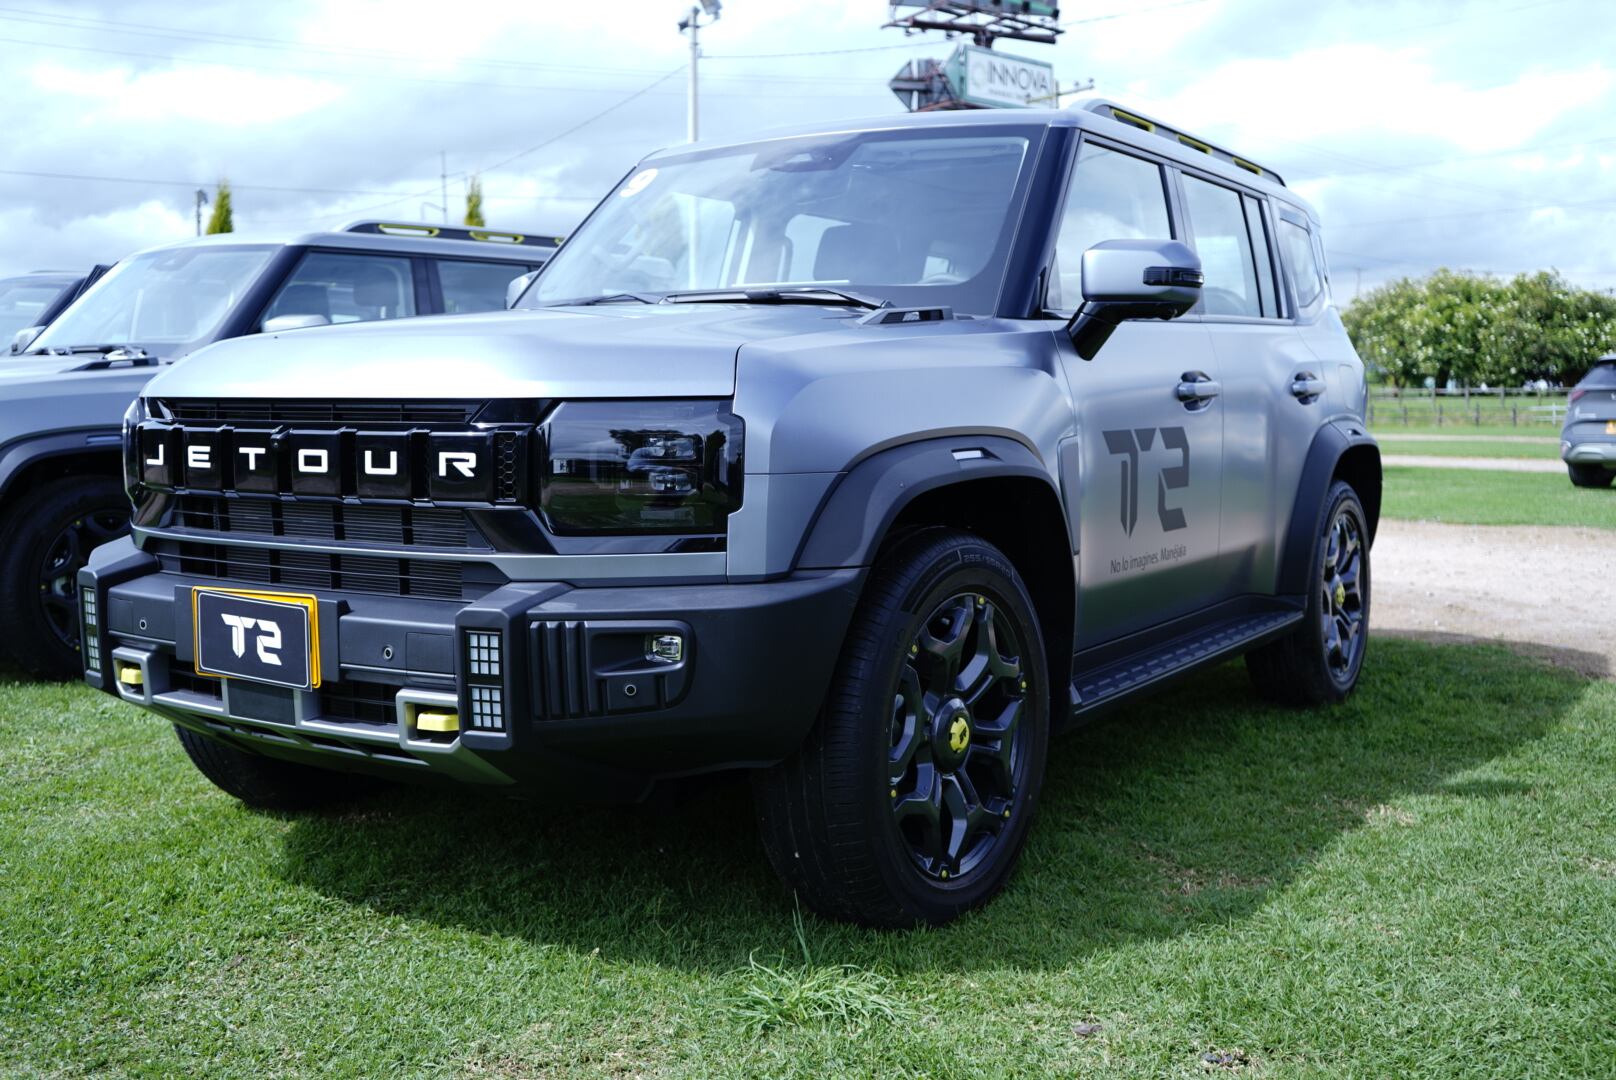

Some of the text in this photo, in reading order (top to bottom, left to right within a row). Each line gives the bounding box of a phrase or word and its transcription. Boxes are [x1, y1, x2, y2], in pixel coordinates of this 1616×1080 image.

[987, 60, 1049, 93] INNOVA
[146, 444, 477, 478] JETOUR
[1102, 427, 1190, 538] T2
[1110, 559, 1121, 574] No
[221, 613, 282, 666] T2
